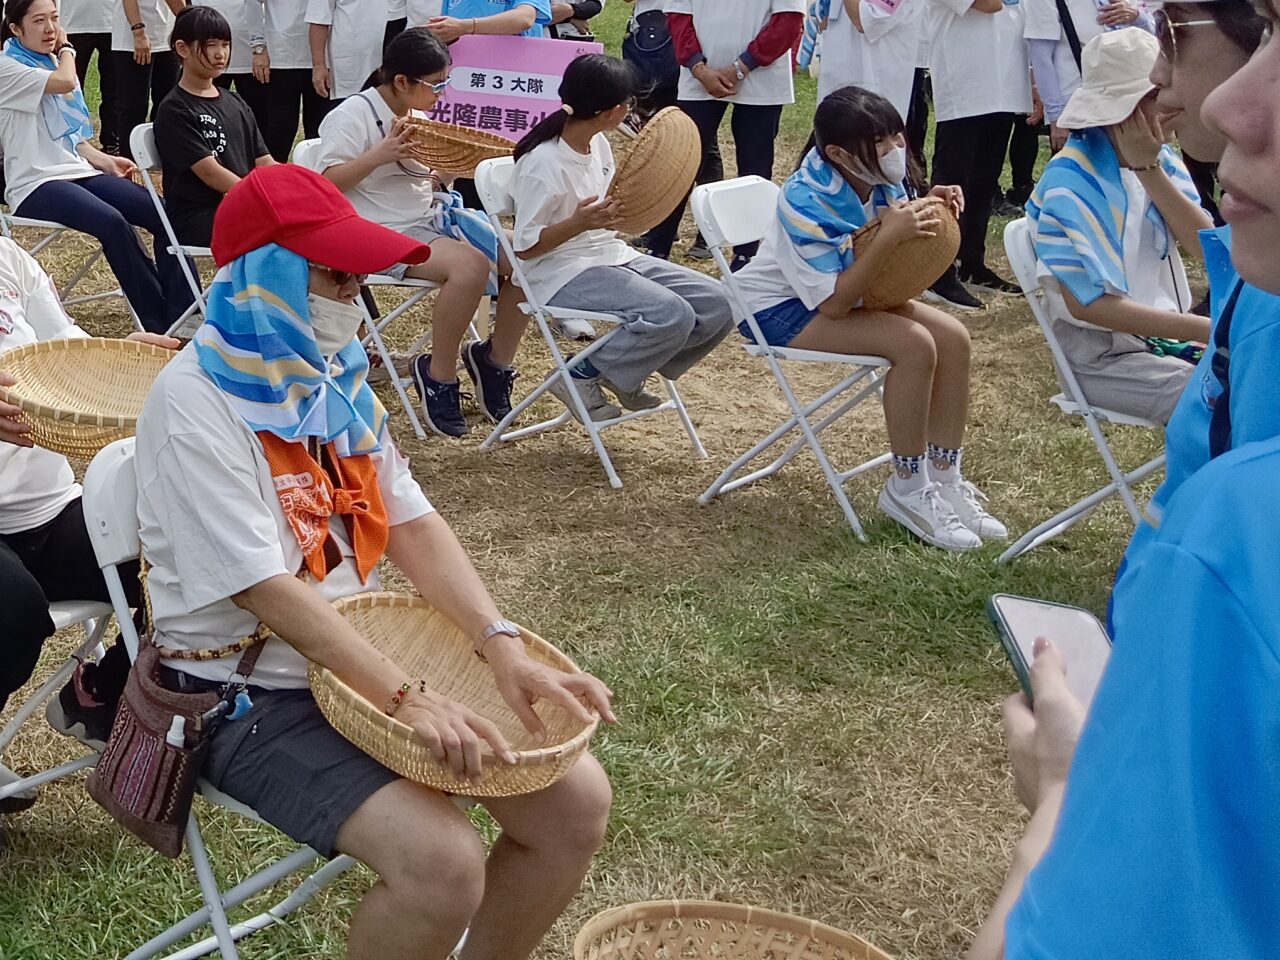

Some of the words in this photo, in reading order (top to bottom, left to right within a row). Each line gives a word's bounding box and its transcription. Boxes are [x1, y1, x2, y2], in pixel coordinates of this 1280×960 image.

[470, 72, 486, 89] 第
[492, 75, 504, 90] 3
[510, 77, 544, 94] 大隊
